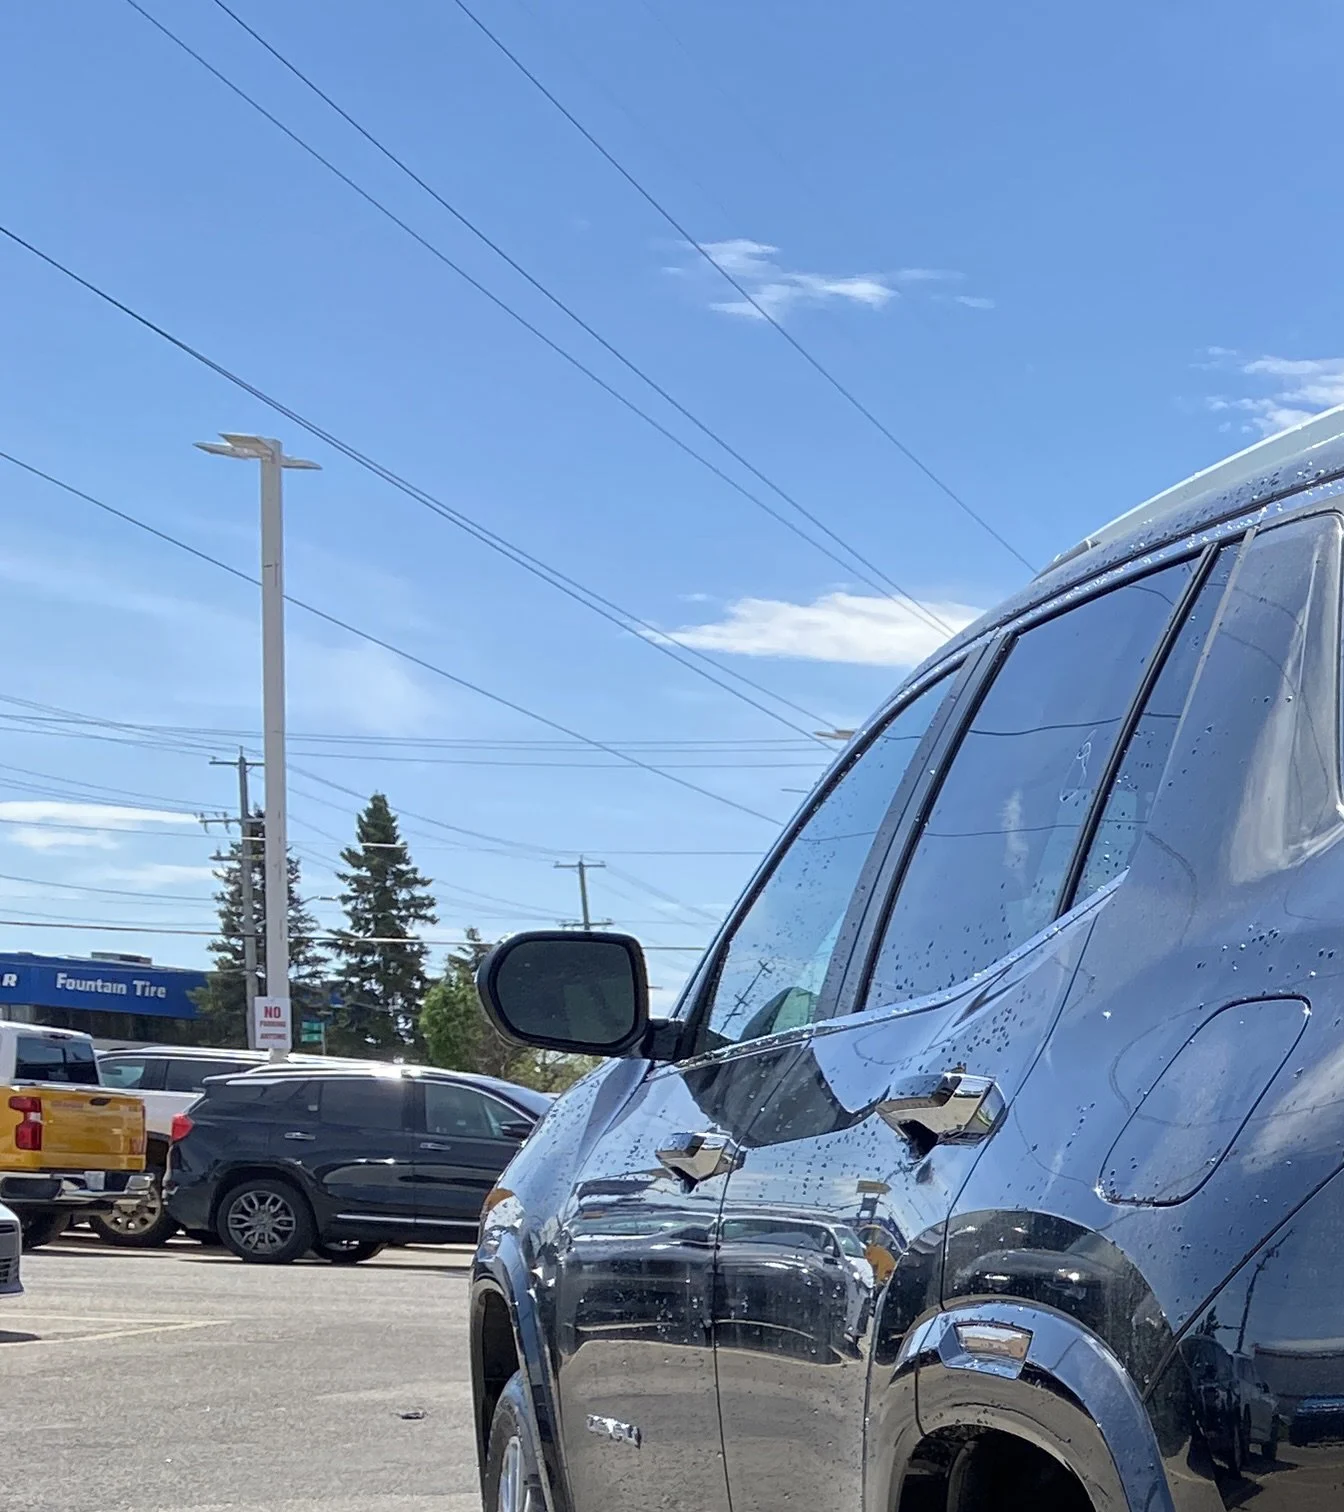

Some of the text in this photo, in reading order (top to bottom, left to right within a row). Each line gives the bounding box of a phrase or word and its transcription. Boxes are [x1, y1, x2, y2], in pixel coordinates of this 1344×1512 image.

[56, 973, 166, 999] Fountain Tire
[263, 1005, 282, 1019] NO
